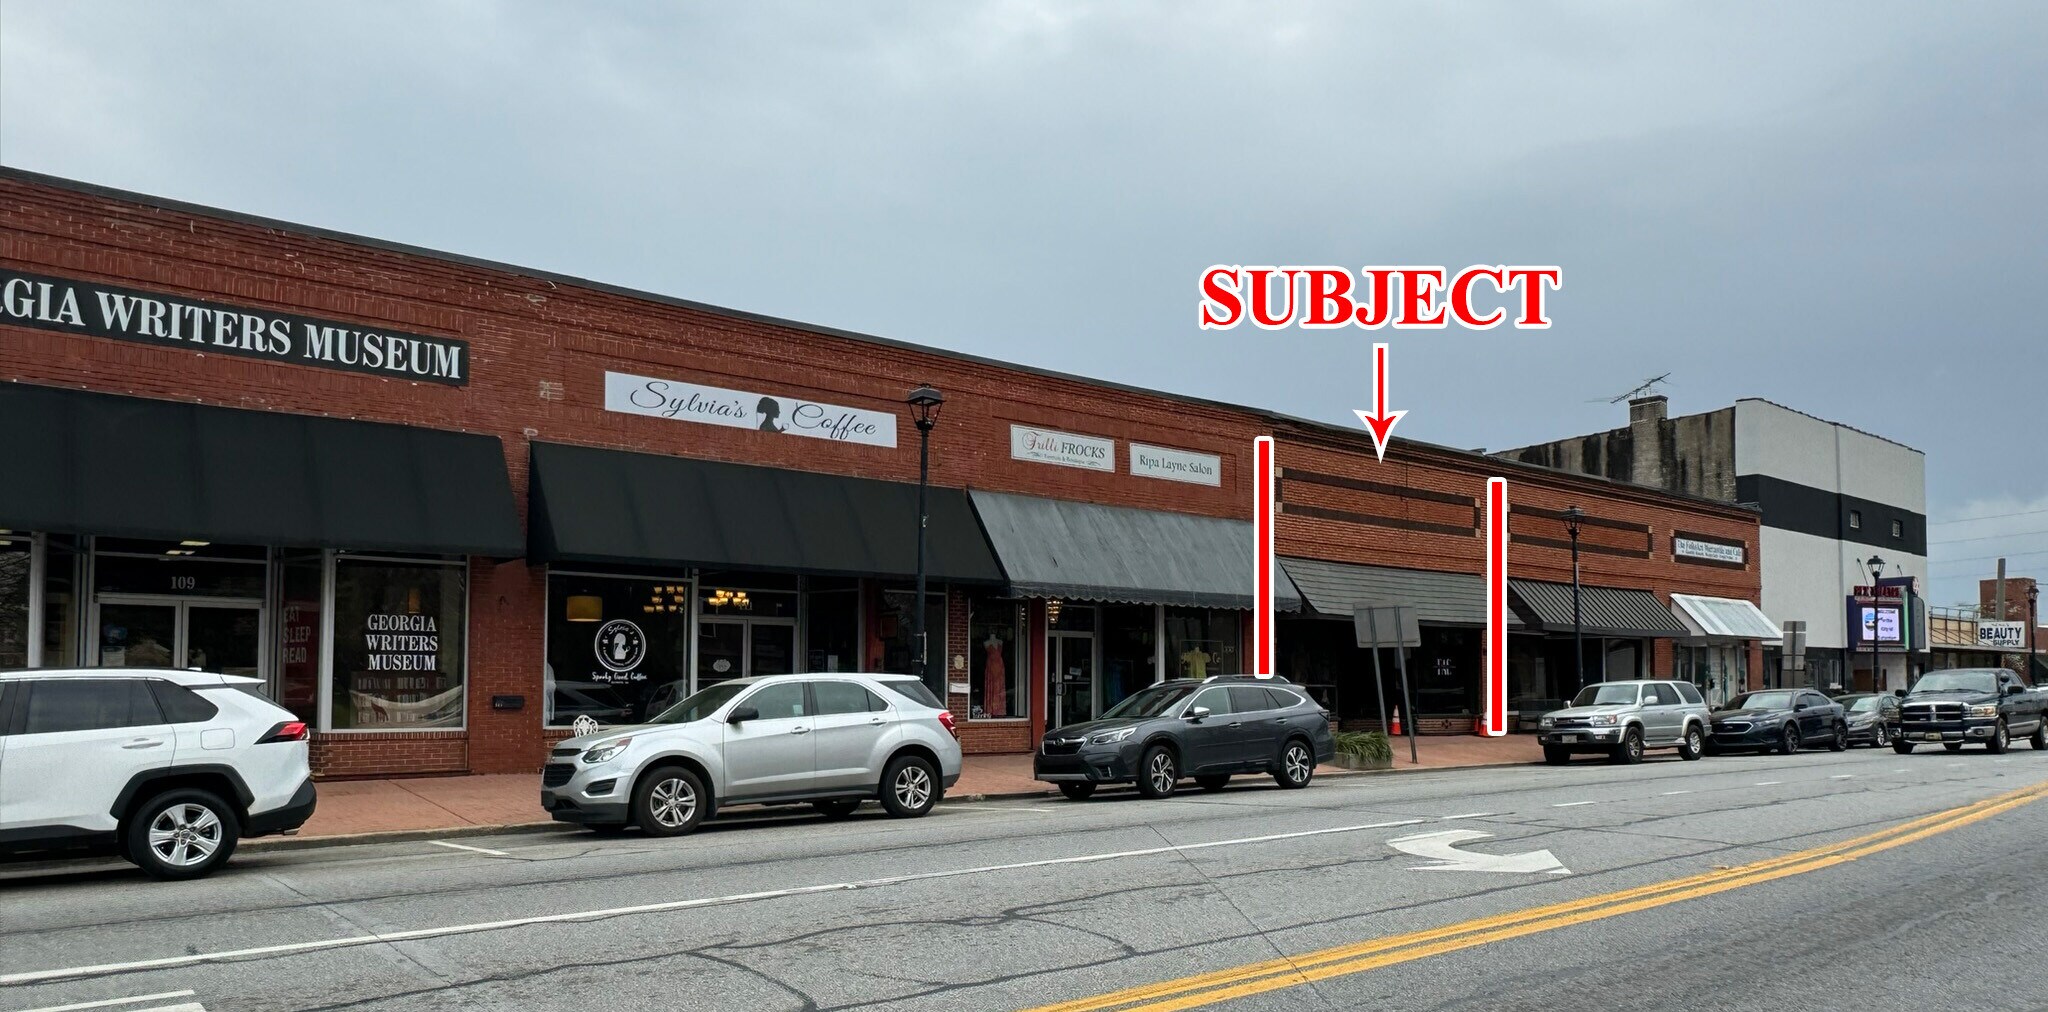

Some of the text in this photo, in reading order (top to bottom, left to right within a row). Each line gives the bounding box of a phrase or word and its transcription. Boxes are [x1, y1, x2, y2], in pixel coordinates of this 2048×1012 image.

[0, 278, 461, 379] GIA WRITERS MUSEUM
[630, 381, 877, 440] Sylvia's Coffee
[1061, 441, 1105, 459] FROCKS
[1139, 454, 1213, 475] Ripa Layne Salon
[171, 576, 196, 590] 109
[283, 605, 299, 622] EAT
[367, 613, 437, 632] GEORGIA
[282, 626, 311, 643] SLEEP
[1980, 627, 2022, 640] BEAUTY
[365, 634, 438, 652] WRITERS
[1993, 639, 2020, 647] SUPPLY
[282, 647, 307, 663] READ
[367, 654, 437, 671] MUSEUM
